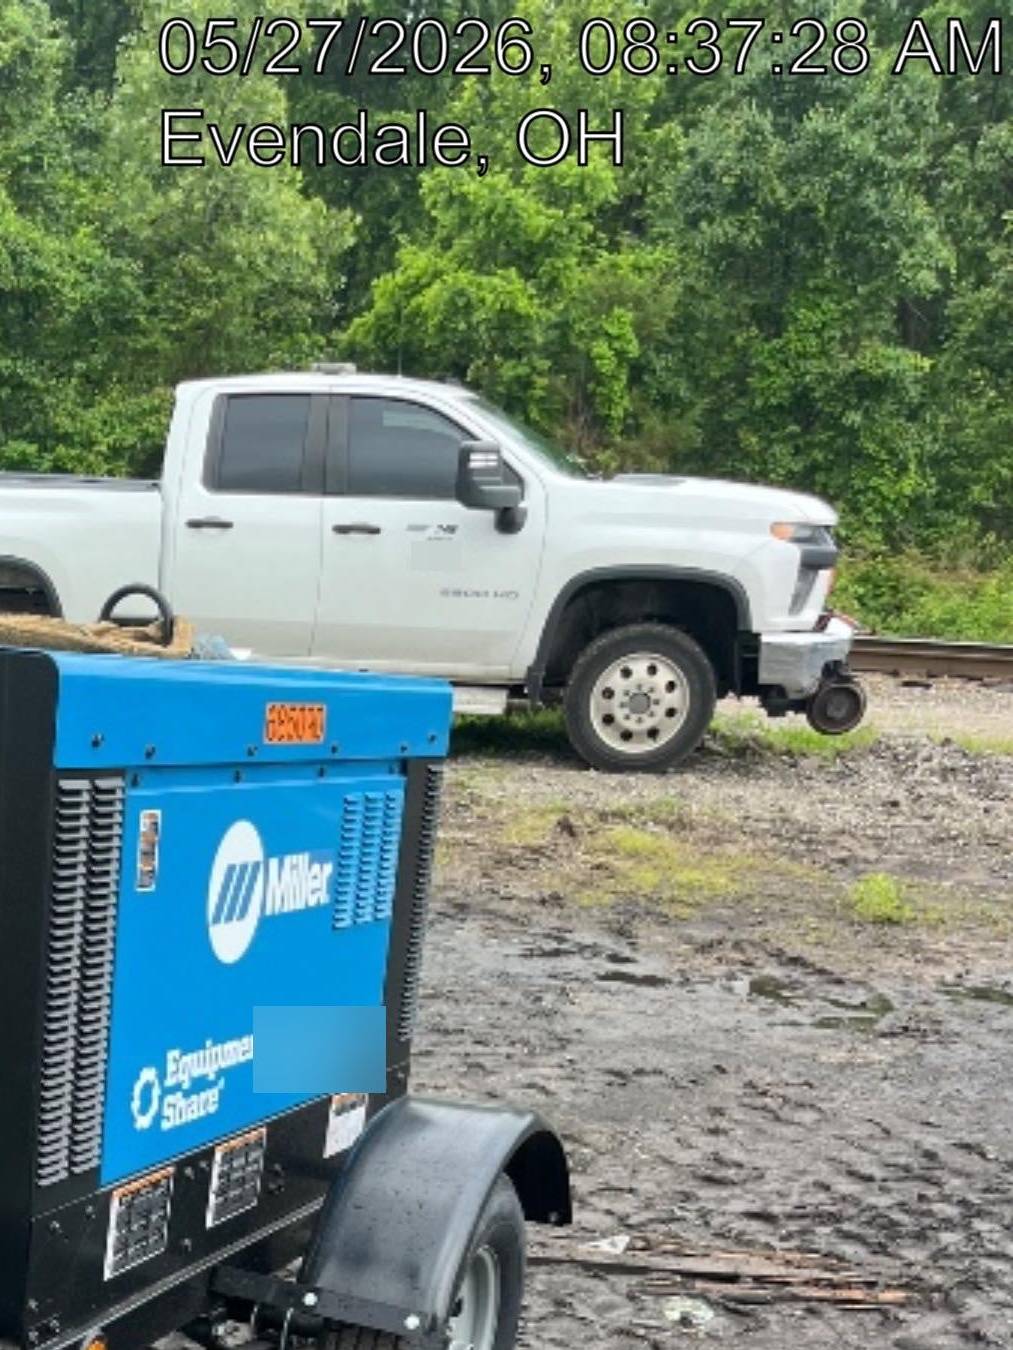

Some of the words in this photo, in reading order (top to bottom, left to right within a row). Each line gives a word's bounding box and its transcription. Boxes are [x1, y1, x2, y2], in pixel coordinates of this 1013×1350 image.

[264, 851, 333, 916] Miller
[164, 1033, 253, 1089] Equipme
[160, 1084, 220, 1131] Share
